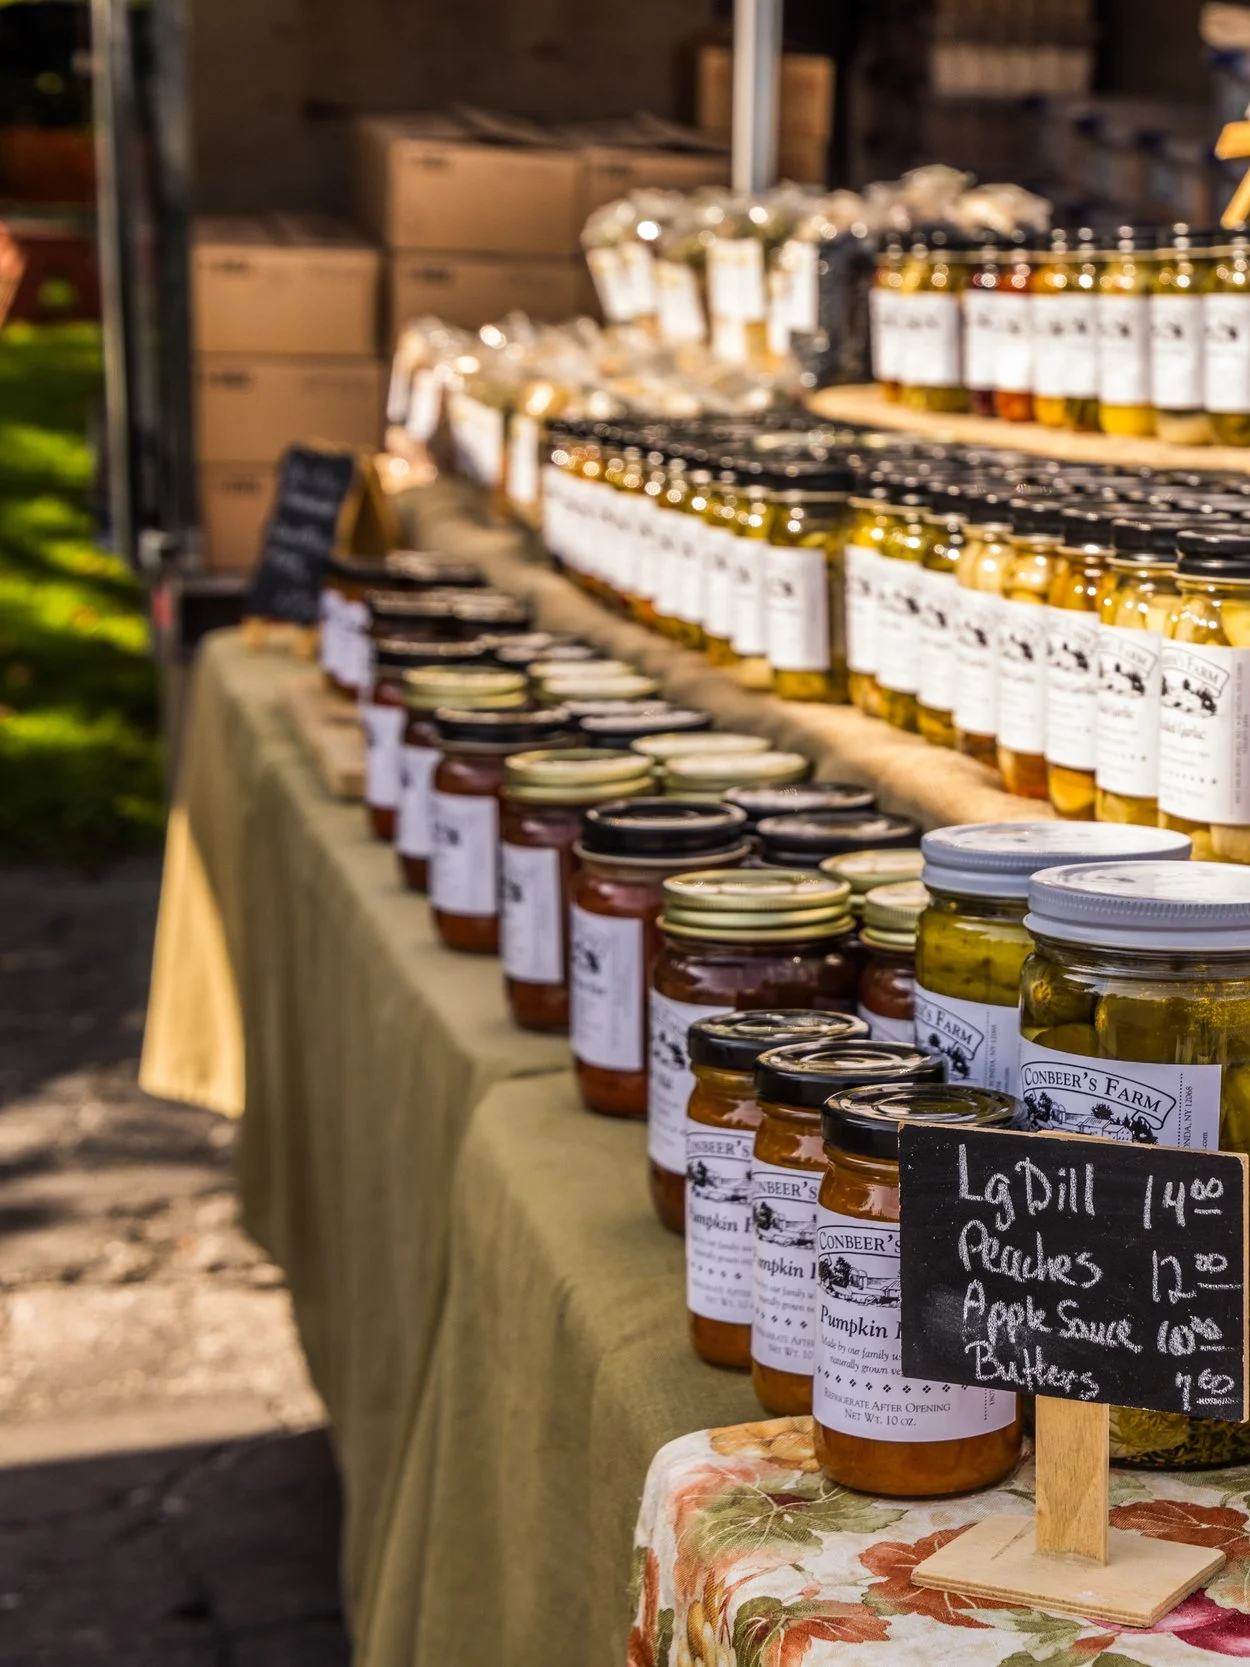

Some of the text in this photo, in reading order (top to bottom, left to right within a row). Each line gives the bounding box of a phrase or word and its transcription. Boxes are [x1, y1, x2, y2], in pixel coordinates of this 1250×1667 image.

[936, 1010, 973, 1045] FARM
[1024, 1067, 1164, 1114] CONBEER'S FARM
[1184, 1086, 1193, 1122] NY 12068
[958, 1143, 1015, 1232] Lg
[1015, 1156, 1095, 1216] Dill
[692, 1213, 738, 1232] umpkin
[819, 1232, 900, 1253] CONBEER'S
[957, 1219, 1105, 1289] Peaches
[758, 1258, 803, 1278] mpkin
[820, 1304, 889, 1339] Pumpkin
[962, 1279, 1052, 1345] Apple
[1056, 1299, 1143, 1354] Sauce
[830, 1355, 888, 1374] naturally grown
[838, 1342, 845, 1355] by
[847, 1346, 860, 1356] our
[861, 1346, 889, 1363] family
[964, 1339, 1100, 1401] Butters
[824, 1387, 951, 1413] REFRIGERATE AFTER OPENING
[845, 1409, 866, 1421] NET
[865, 1411, 882, 1425] WT.
[886, 1415, 897, 1425] 10
